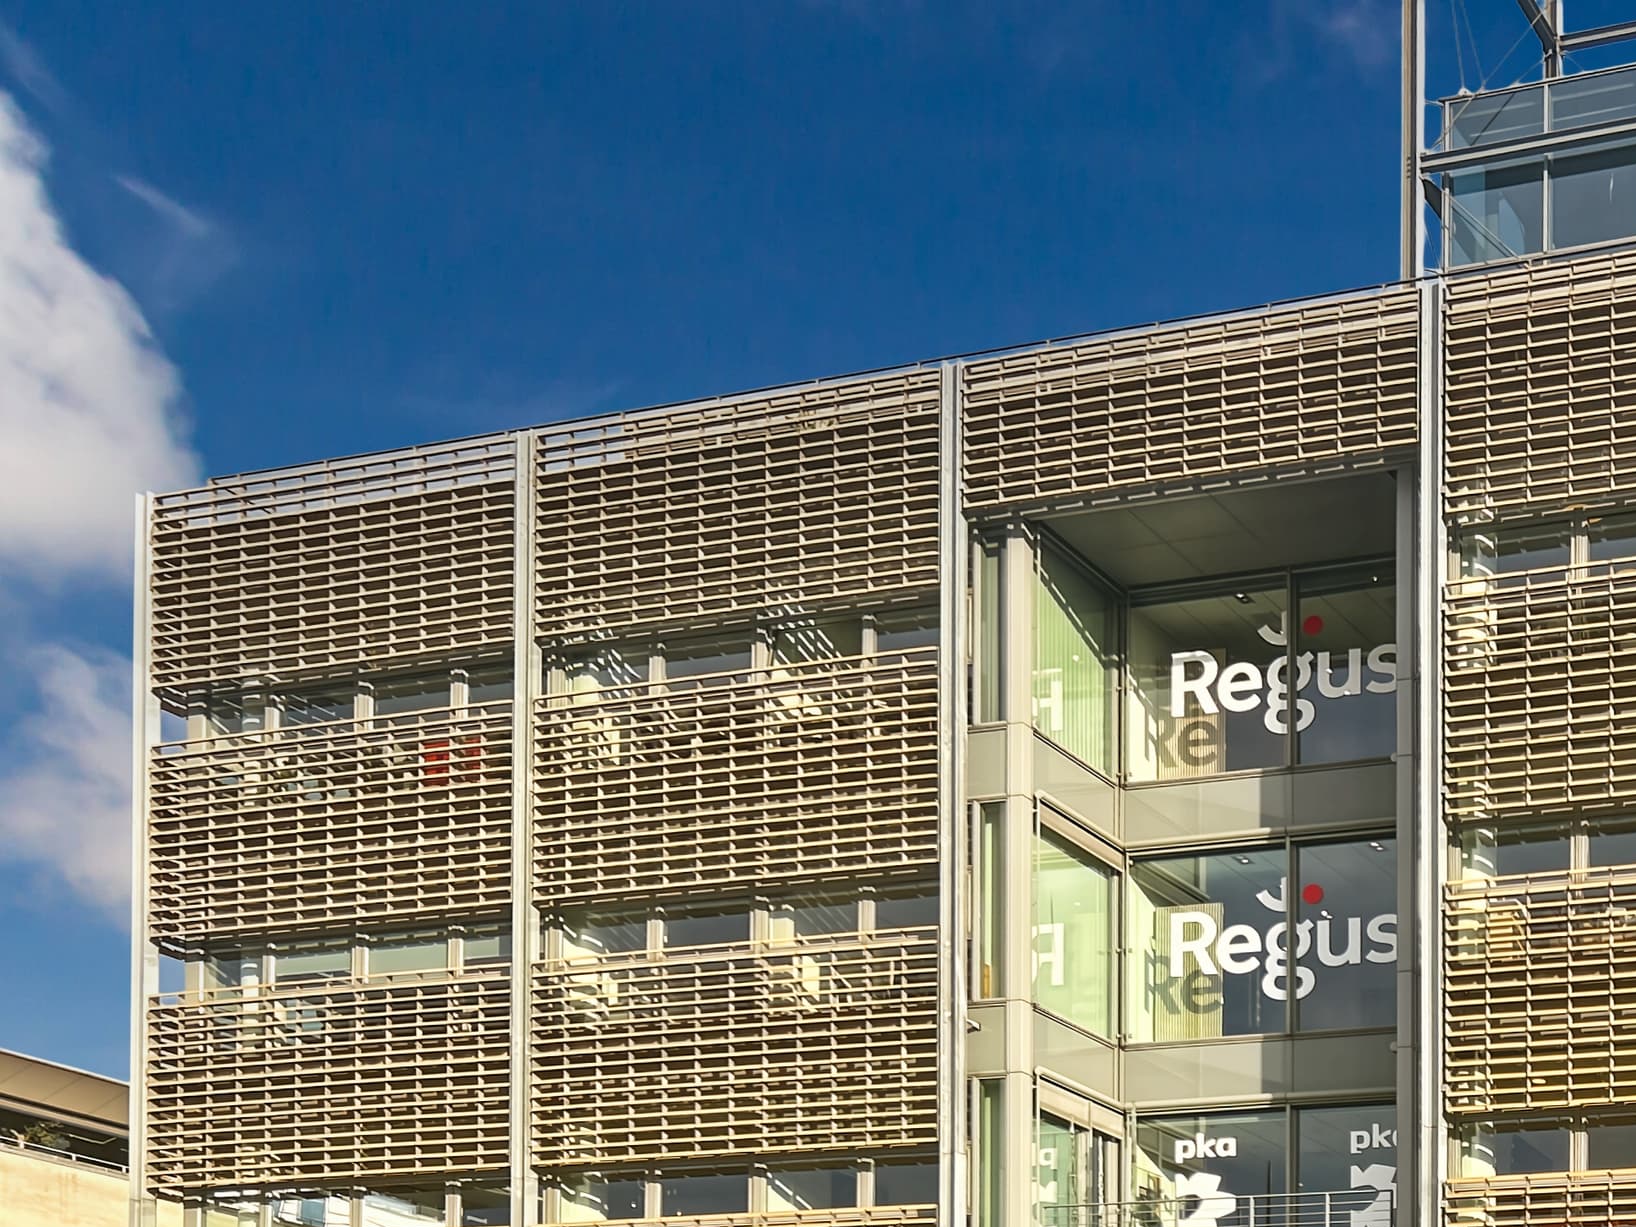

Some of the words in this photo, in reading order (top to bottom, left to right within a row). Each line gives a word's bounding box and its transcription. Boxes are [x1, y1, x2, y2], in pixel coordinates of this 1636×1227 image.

[1171, 644, 1397, 734] Regus
[1170, 911, 1397, 1000] Regus
[1174, 1132, 1237, 1164] pka
[1350, 1123, 1397, 1154] pk
